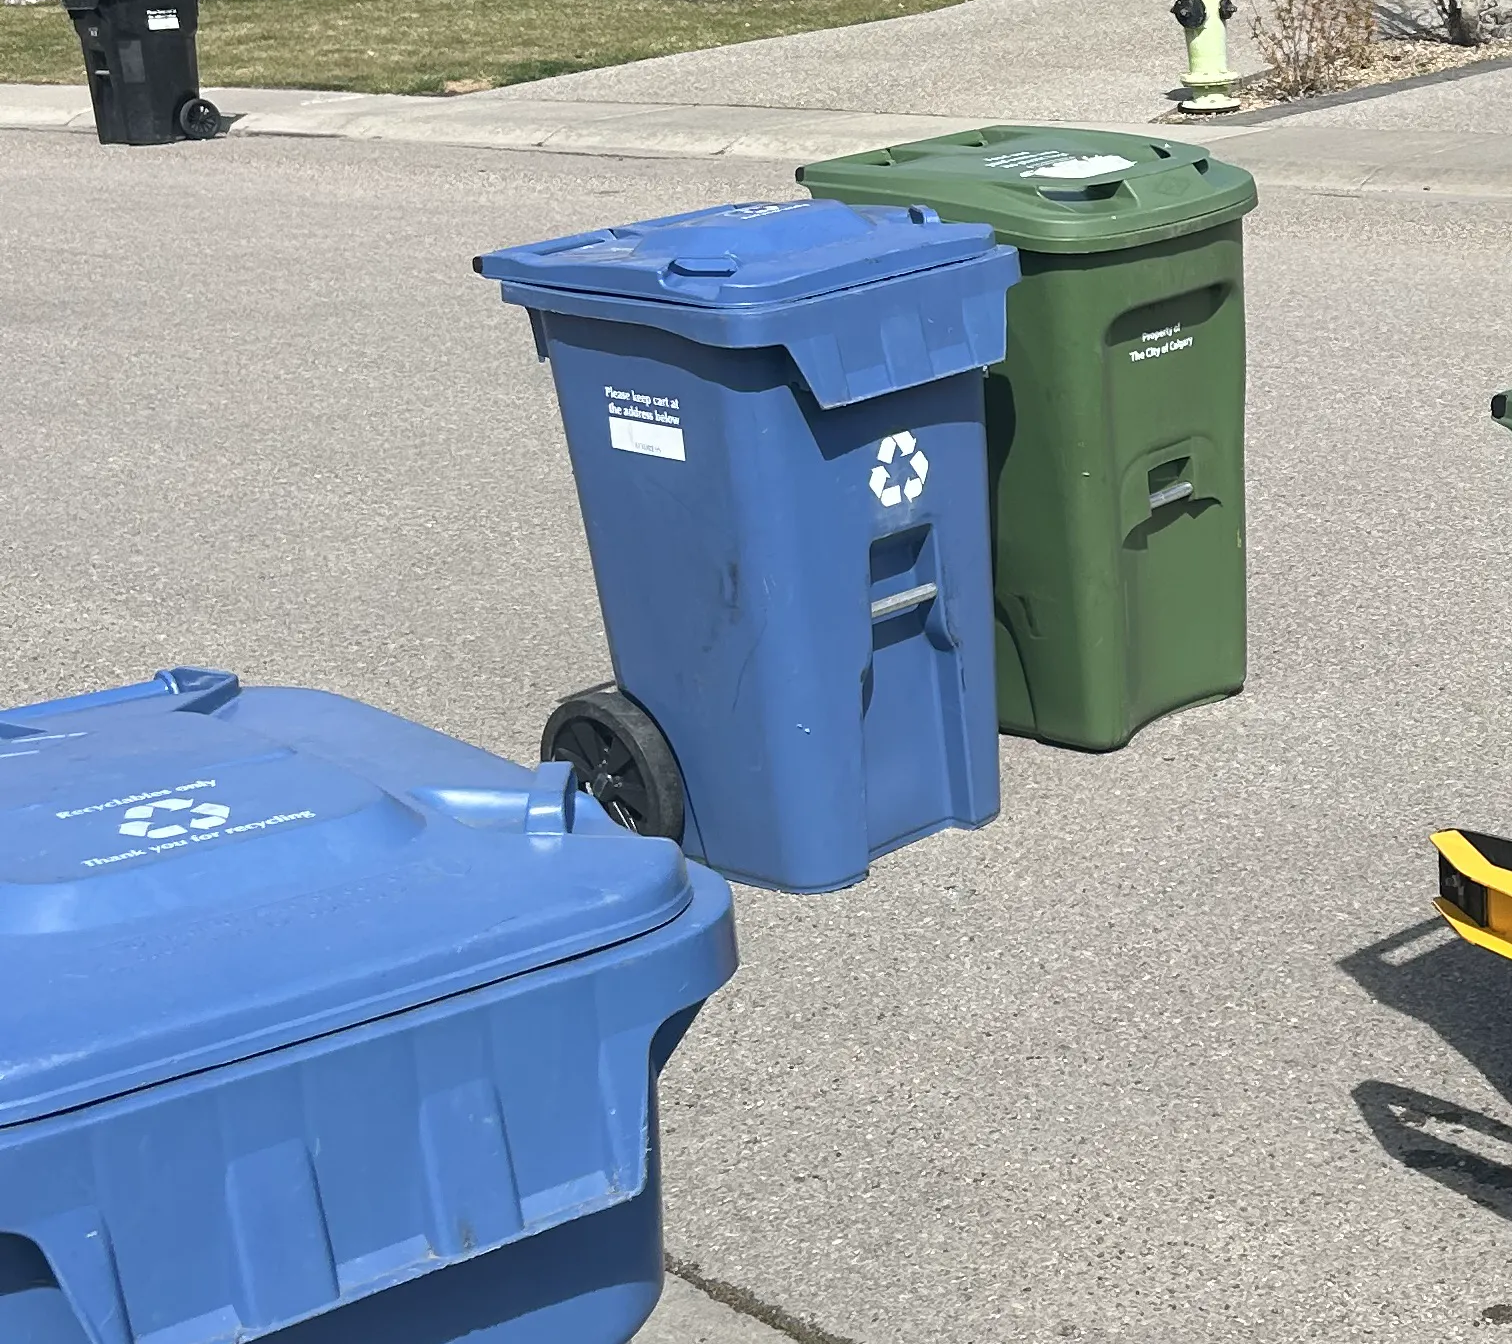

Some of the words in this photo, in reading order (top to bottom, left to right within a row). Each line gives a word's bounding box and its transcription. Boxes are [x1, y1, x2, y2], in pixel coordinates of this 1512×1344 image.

[1142, 326, 1172, 342] Property
[1173, 322, 1182, 333] of
[1129, 350, 1145, 362] The
[1146, 347, 1160, 358] City
[1162, 342, 1168, 354] of
[1170, 336, 1194, 351] Calgary
[604, 386, 630, 400] Please
[631, 390, 652, 407] keep
[652, 396, 670, 408] cart
[670, 398, 680, 410] at
[608, 402, 622, 416] the
[623, 406, 654, 420] address
[654, 410, 680, 426] below
[55, 788, 173, 820] Recyclables
[174, 779, 216, 793] only
[80, 848, 148, 868] Thank
[150, 838, 188, 854] you
[190, 830, 221, 844] for
[224, 809, 317, 836] recycling
